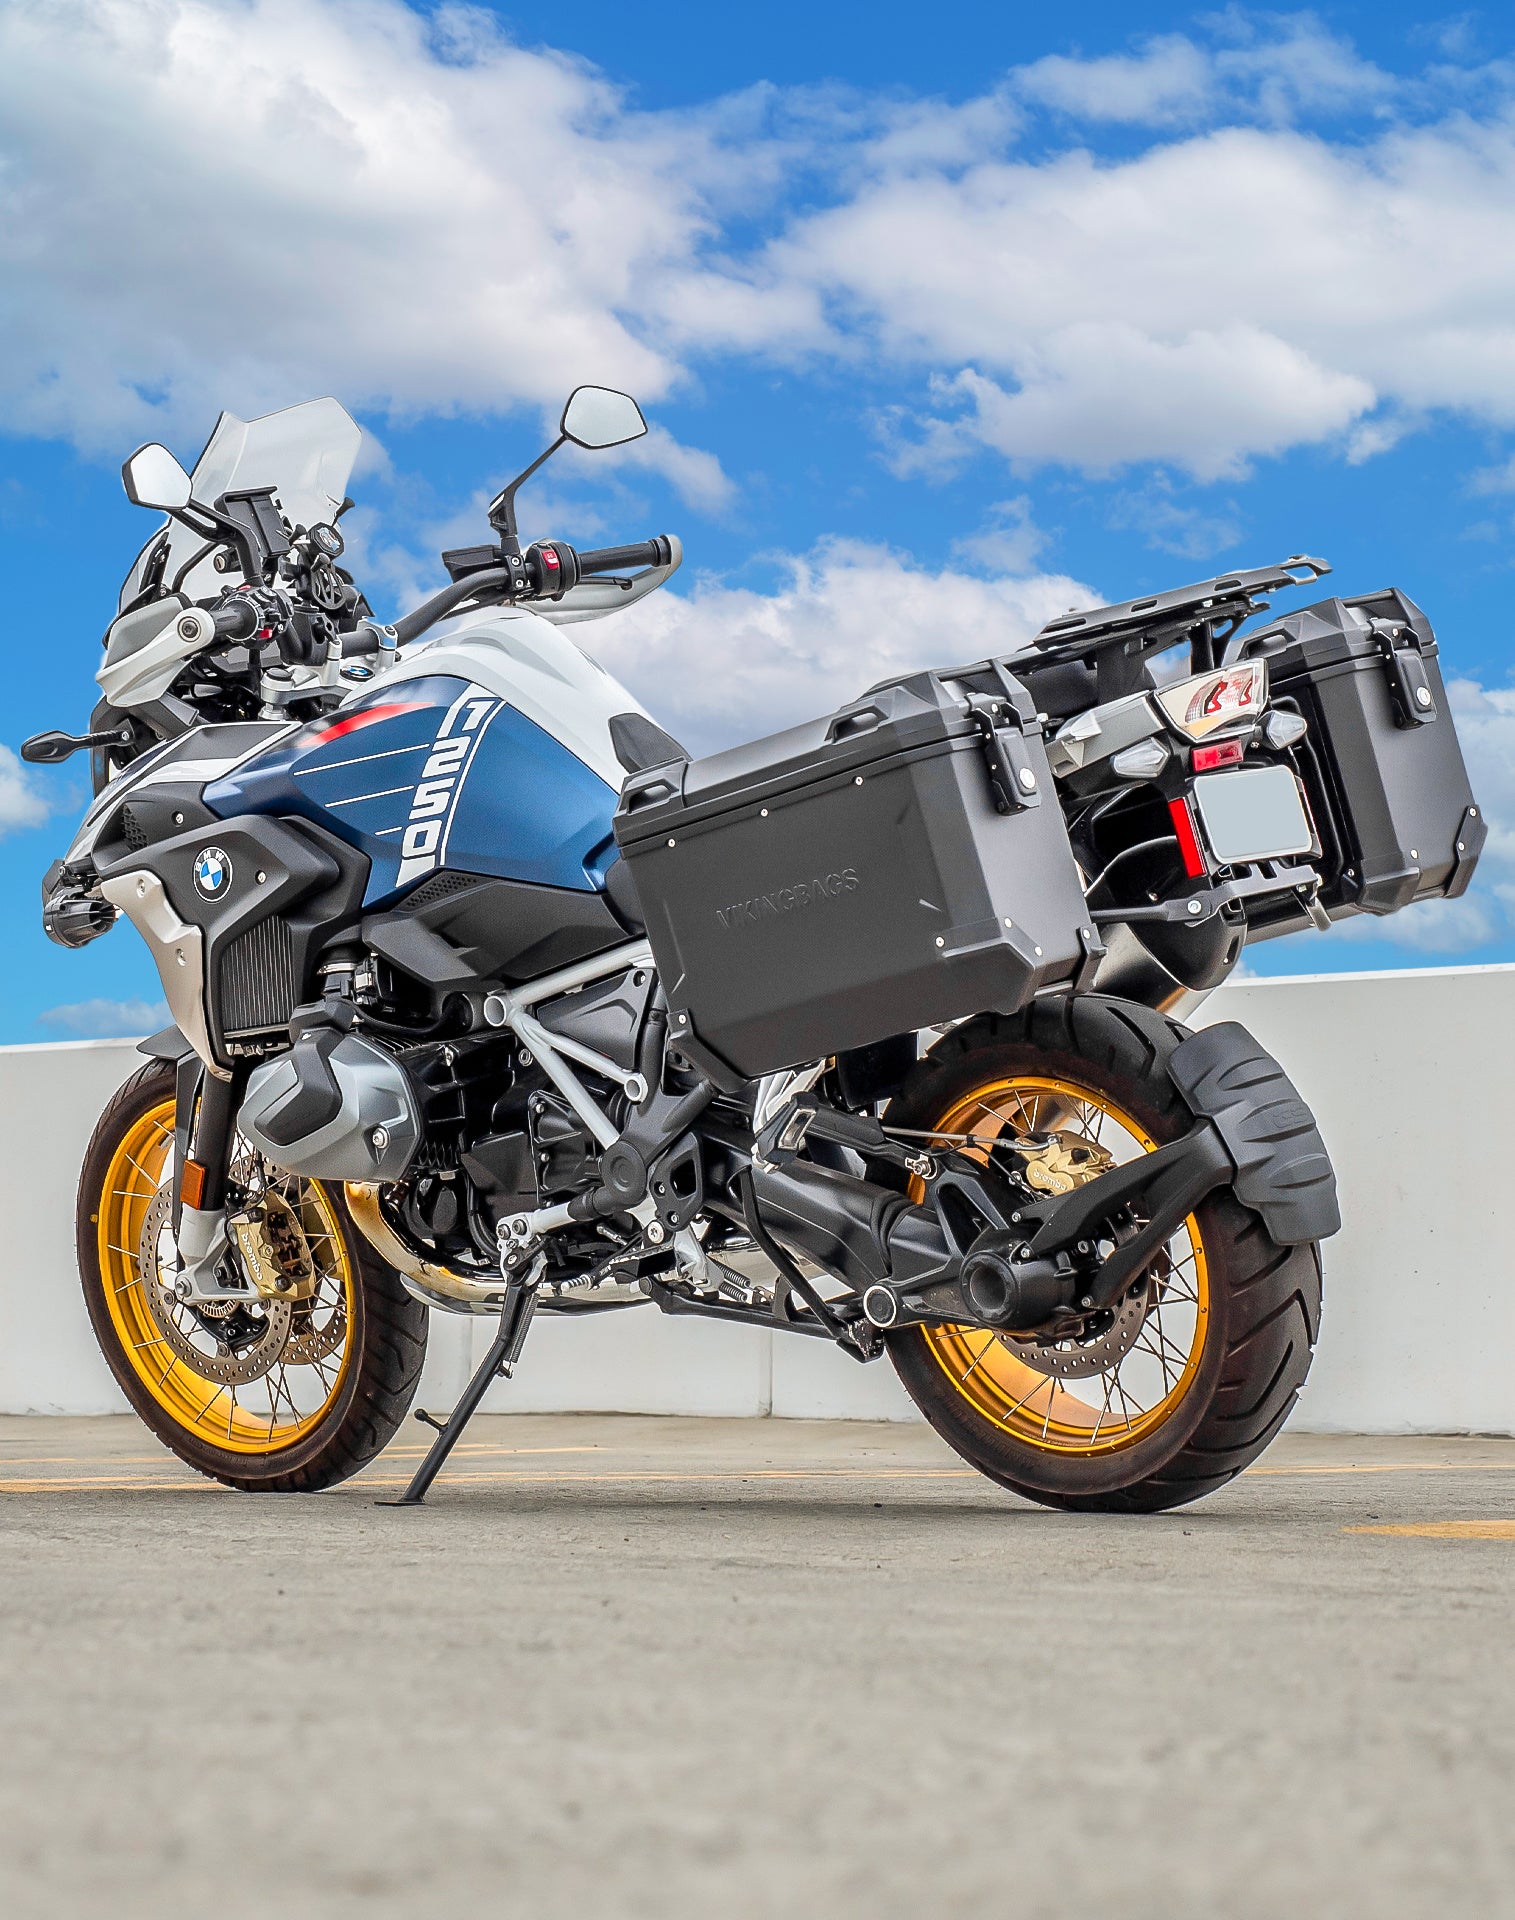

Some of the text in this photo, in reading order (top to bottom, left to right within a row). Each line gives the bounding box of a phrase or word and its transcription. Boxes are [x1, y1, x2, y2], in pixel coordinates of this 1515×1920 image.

[401, 700, 497, 858] 1250
[195, 849, 225, 872] BMW
[716, 868, 860, 931] VIKINGBAGS
[1033, 1168, 1067, 1191] brembo
[241, 1231, 263, 1281] brembo
